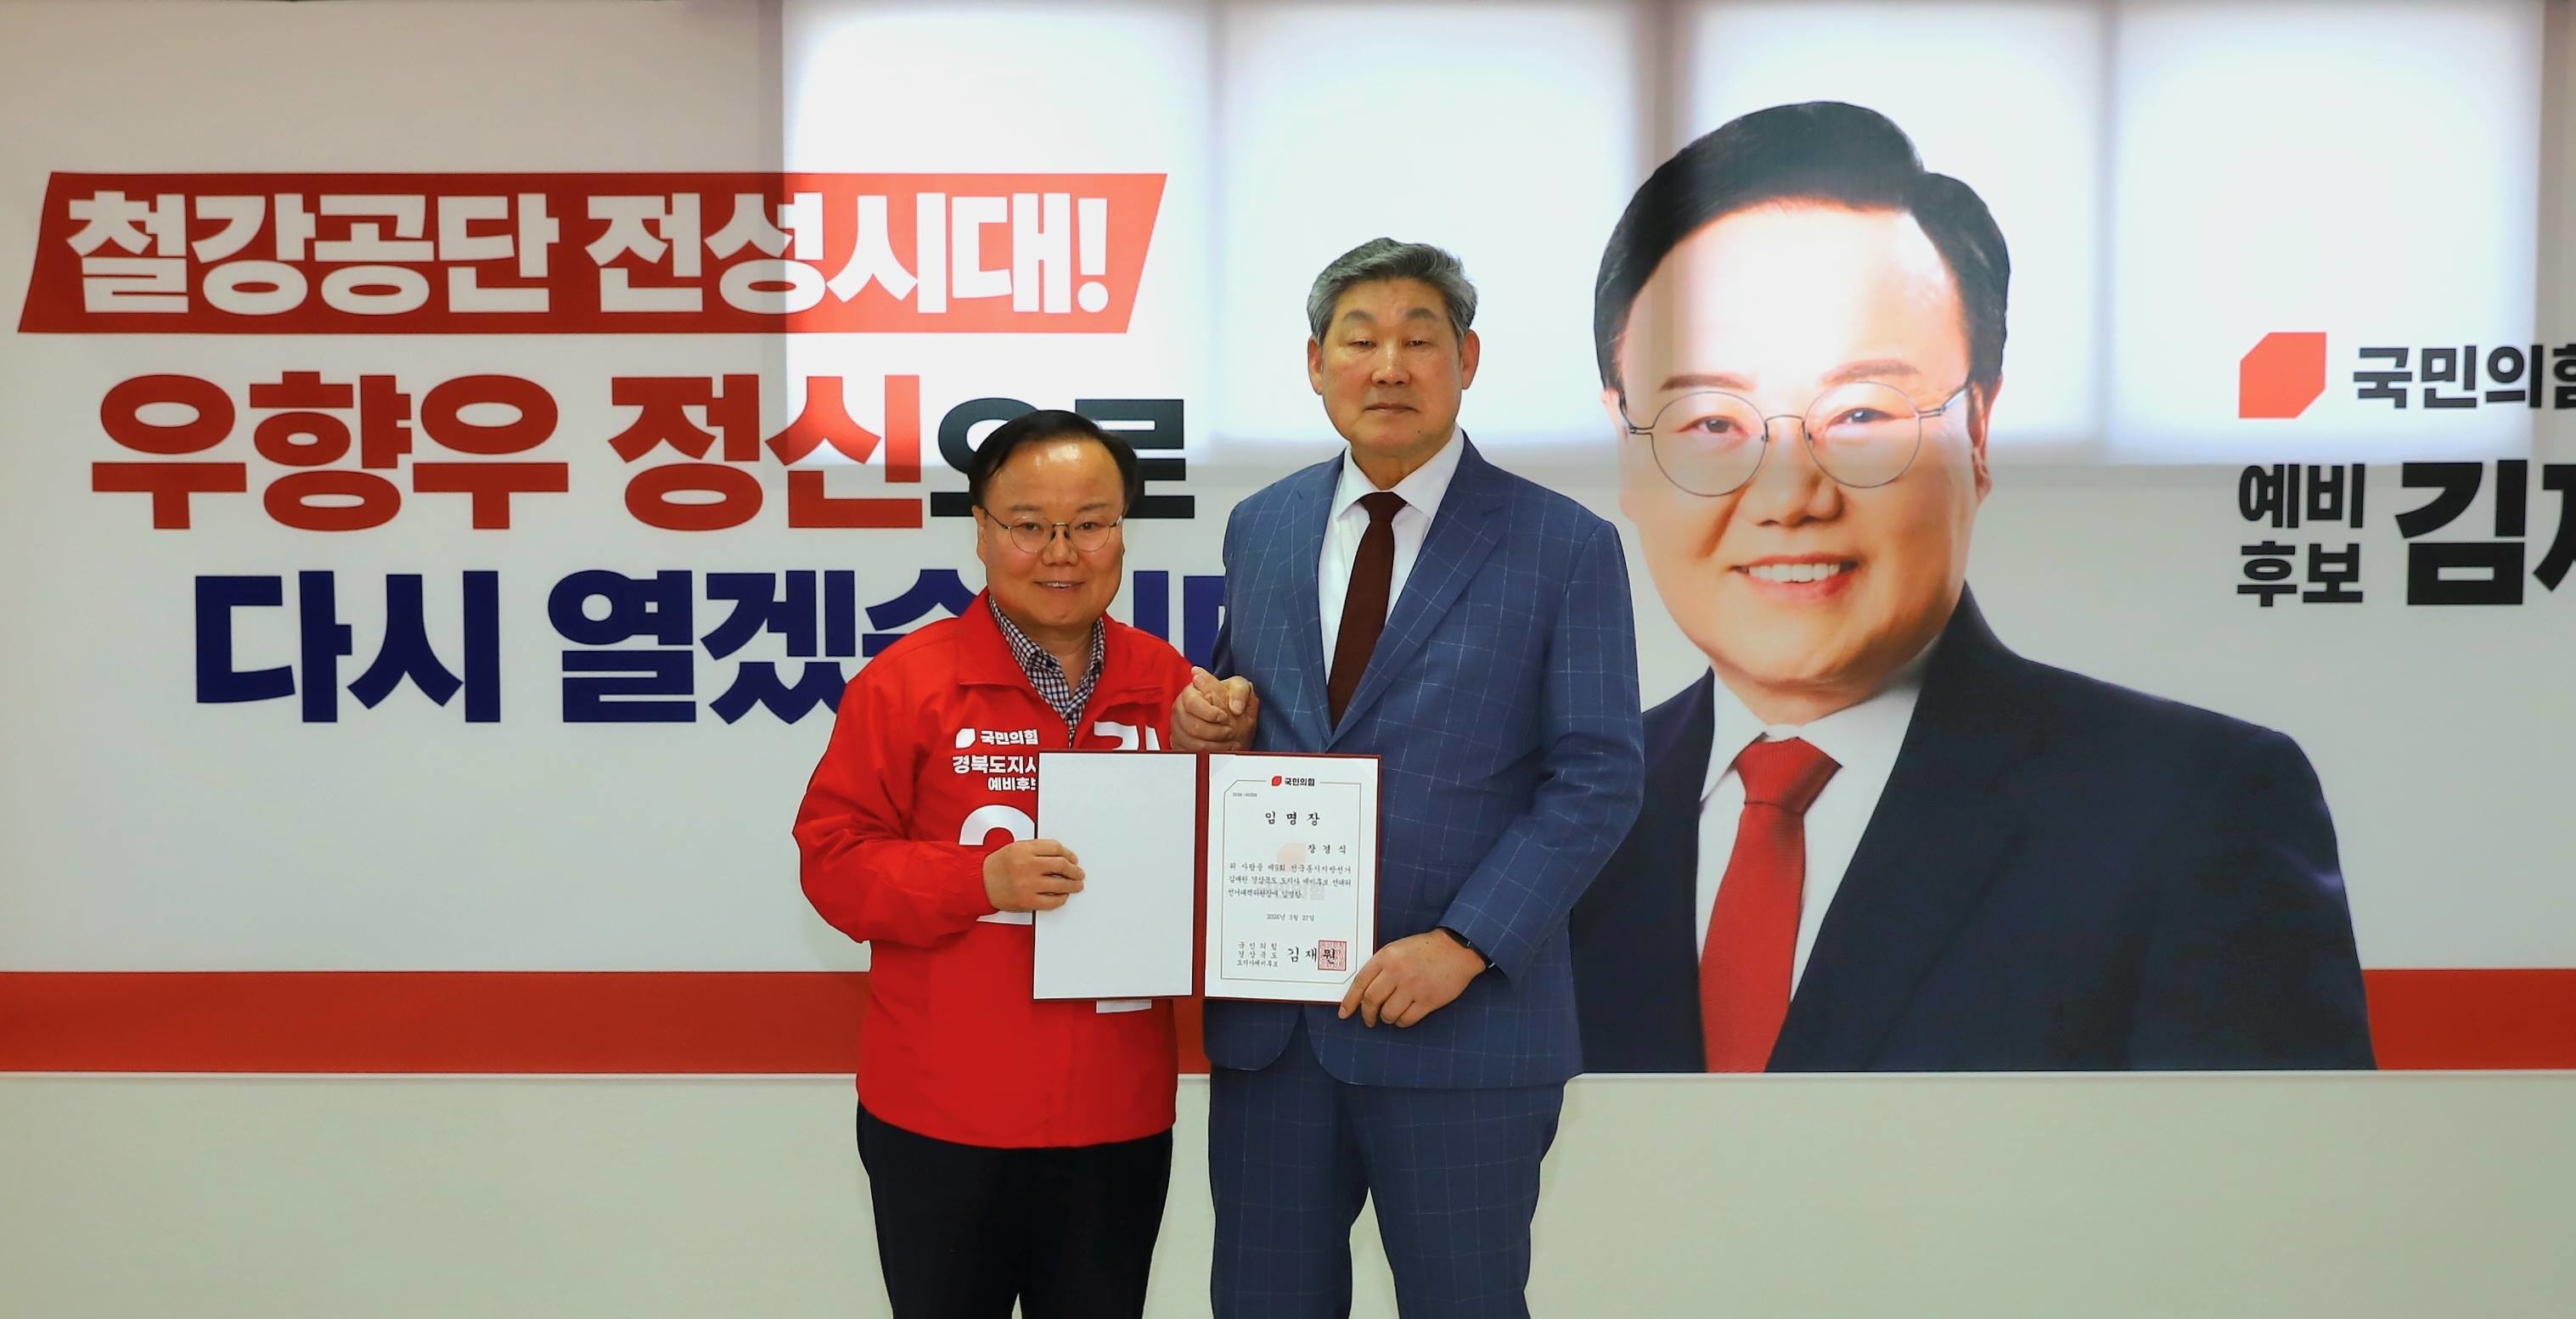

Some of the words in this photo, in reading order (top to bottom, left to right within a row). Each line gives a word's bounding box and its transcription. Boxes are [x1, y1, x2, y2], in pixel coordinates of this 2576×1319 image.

[65, 190, 560, 316] 철강공단
[584, 191, 1109, 315] 전성시대!
[92, 370, 569, 532] 우향우
[2238, 463, 2365, 530] 예비
[2236, 541, 2364, 608] 후보
[194, 570, 501, 723] 다시
[980, 728, 1039, 745] 국민의힘
[1285, 777, 1315, 787] 국민의힘
